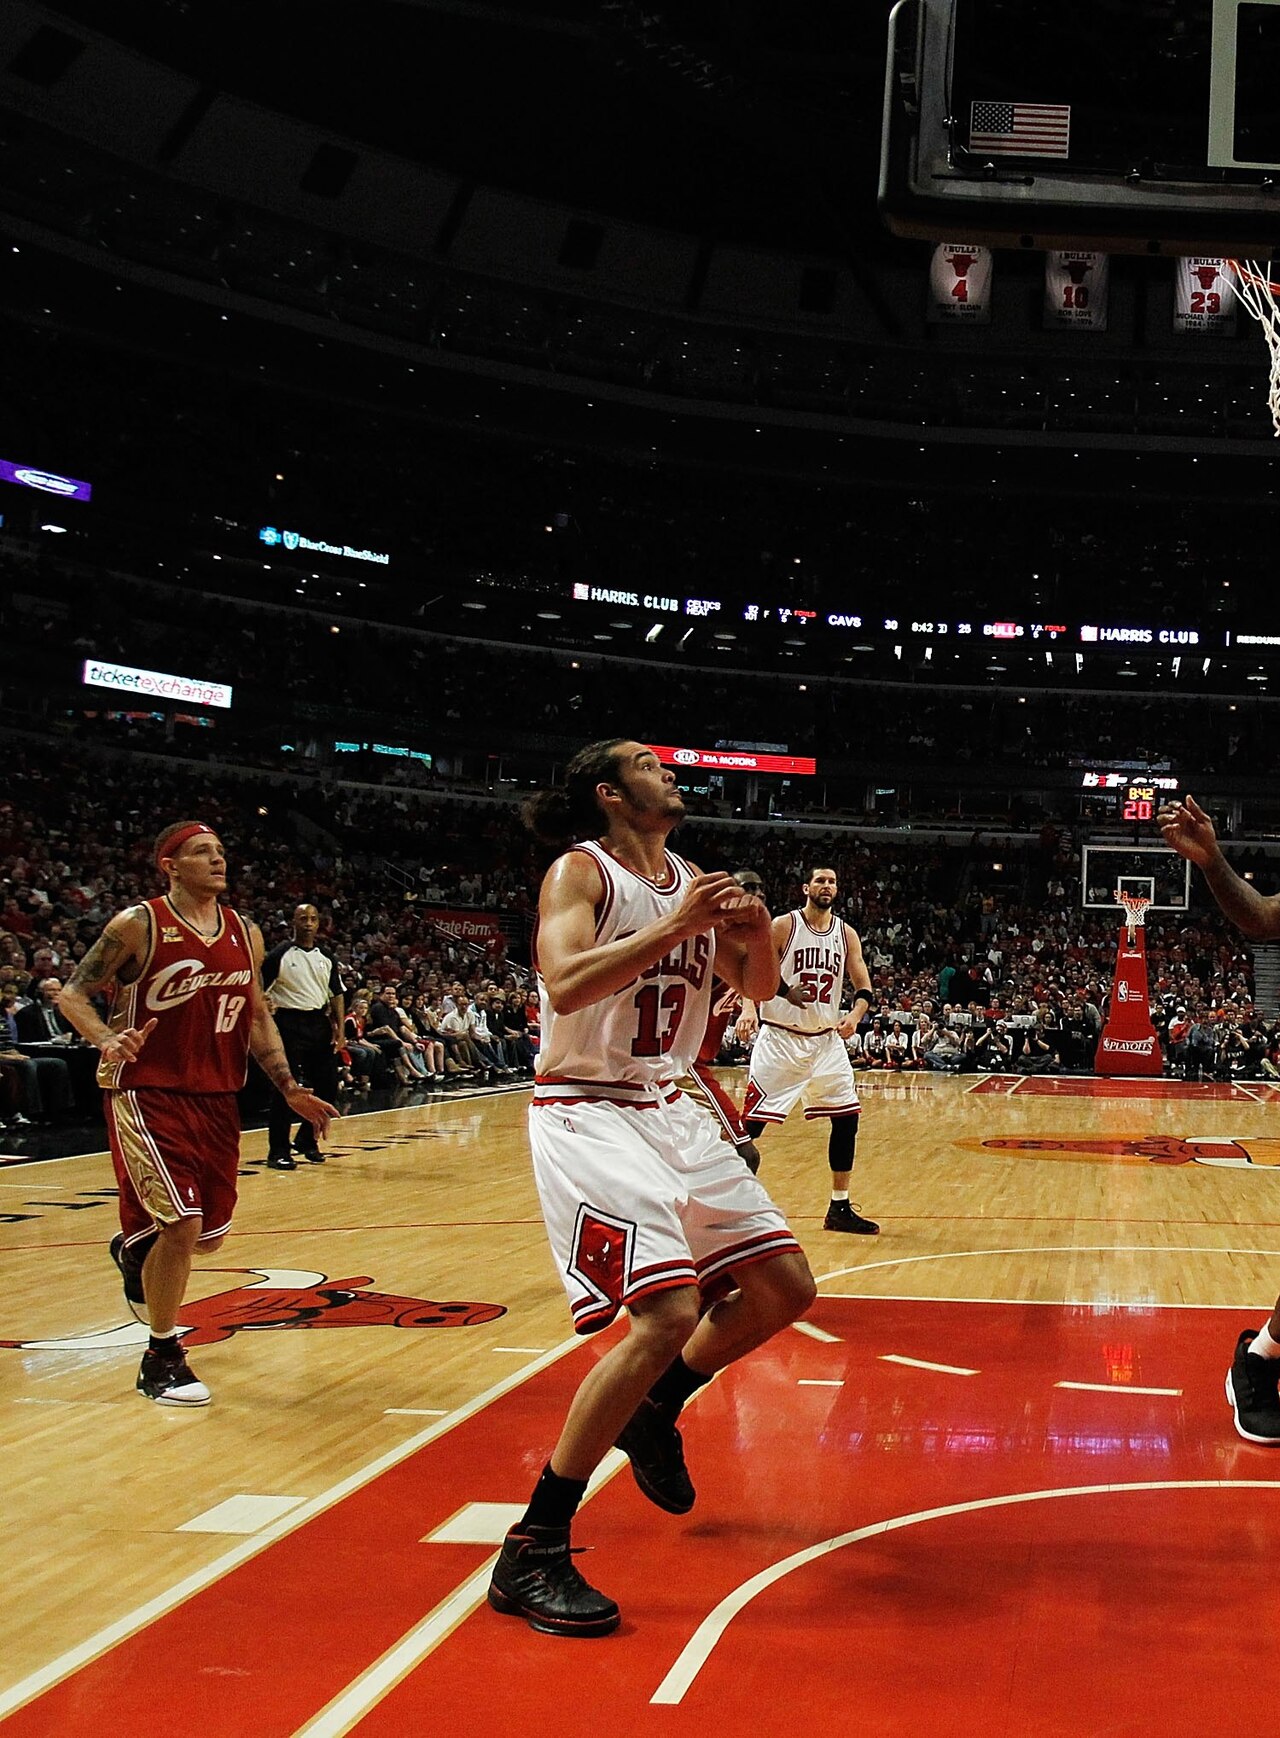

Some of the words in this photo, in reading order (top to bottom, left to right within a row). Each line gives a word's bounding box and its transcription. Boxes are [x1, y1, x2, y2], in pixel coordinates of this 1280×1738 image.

[1193, 258, 1220, 266] BULLS
[952, 279, 968, 302] 4
[1063, 286, 1088, 308] 10
[1191, 291, 1220, 313] 23
[299, 537, 342, 554] BlueCross
[344, 546, 389, 564] BlueShield
[643, 595, 678, 611] CLUB
[687, 600, 721, 610] CELTICS
[801, 617, 807, 625] 2
[828, 615, 861, 627] CAVS
[983, 624, 1024, 636] BULLS
[1100, 628, 1153, 642] HARRIS
[1159, 631, 1199, 644] CLUB
[703, 755, 718, 763] KIA
[720, 756, 757, 766] MOTORS
[1129, 787, 1153, 800] 8:42
[1124, 801, 1151, 819] 20
[793, 947, 841, 977] BULLS
[146, 959, 251, 1011] CLEVELAND
[800, 973, 833, 1004] 52
[215, 994, 246, 1033] 13
[631, 983, 687, 1056] 13
[1109, 1041, 1153, 1051] PLAYOFFS
